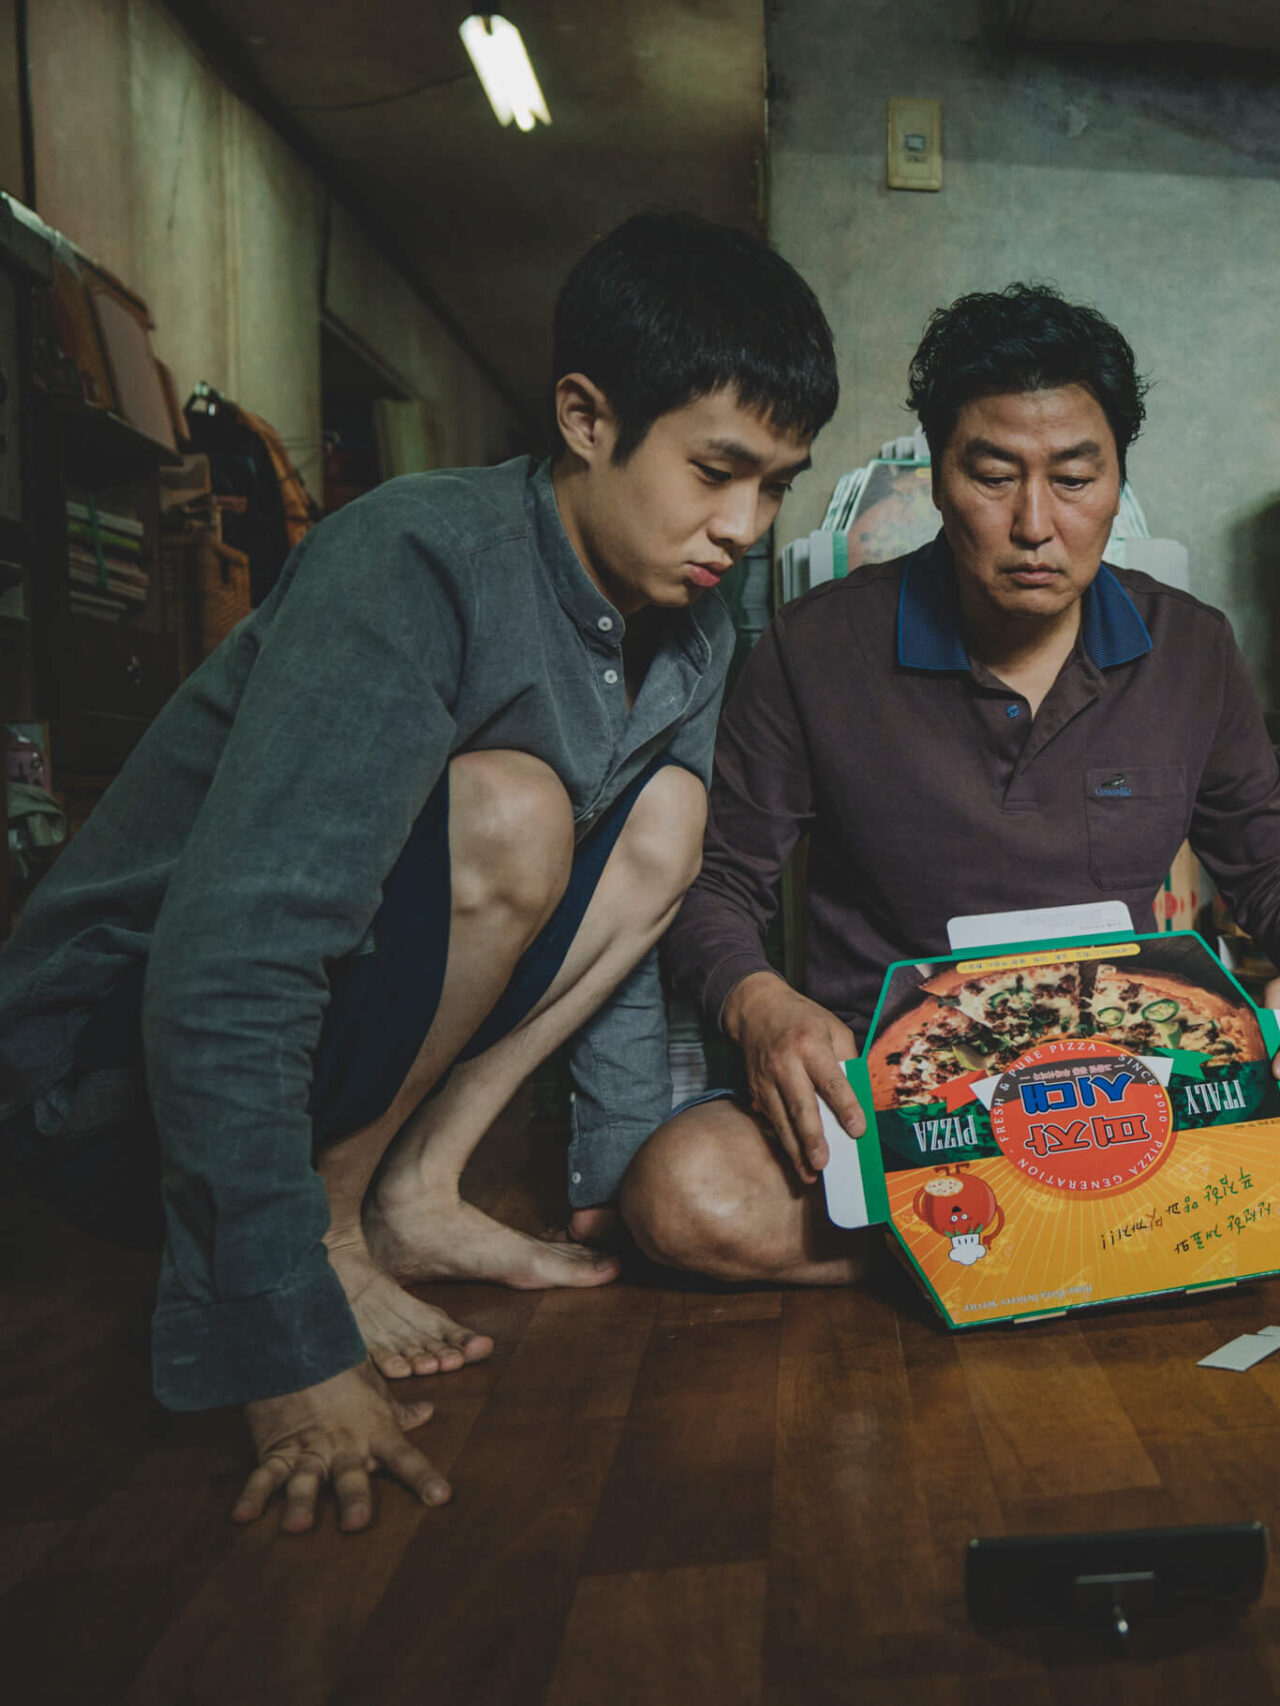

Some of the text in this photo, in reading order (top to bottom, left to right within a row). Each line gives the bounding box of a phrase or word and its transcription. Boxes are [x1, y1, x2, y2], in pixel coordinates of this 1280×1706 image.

[993, 1097, 1010, 1143] FRESH
[1008, 1050, 1043, 1078] PURE
[1049, 1041, 1097, 1054] PIZZA
[1019, 1072, 1134, 1115] 시대
[1117, 1053, 1168, 1123] SINCE 2010
[1184, 1079, 1246, 1115] ITALY
[912, 1114, 978, 1153] PIZZA
[1023, 1113, 1152, 1157] 피자
[1017, 1140, 1164, 1190] PIZZA GENERATION
[1204, 1166, 1253, 1206] 푸짐한
[1166, 1195, 1198, 1215] 양과
[1174, 1201, 1271, 1254] 신선한 재료와
